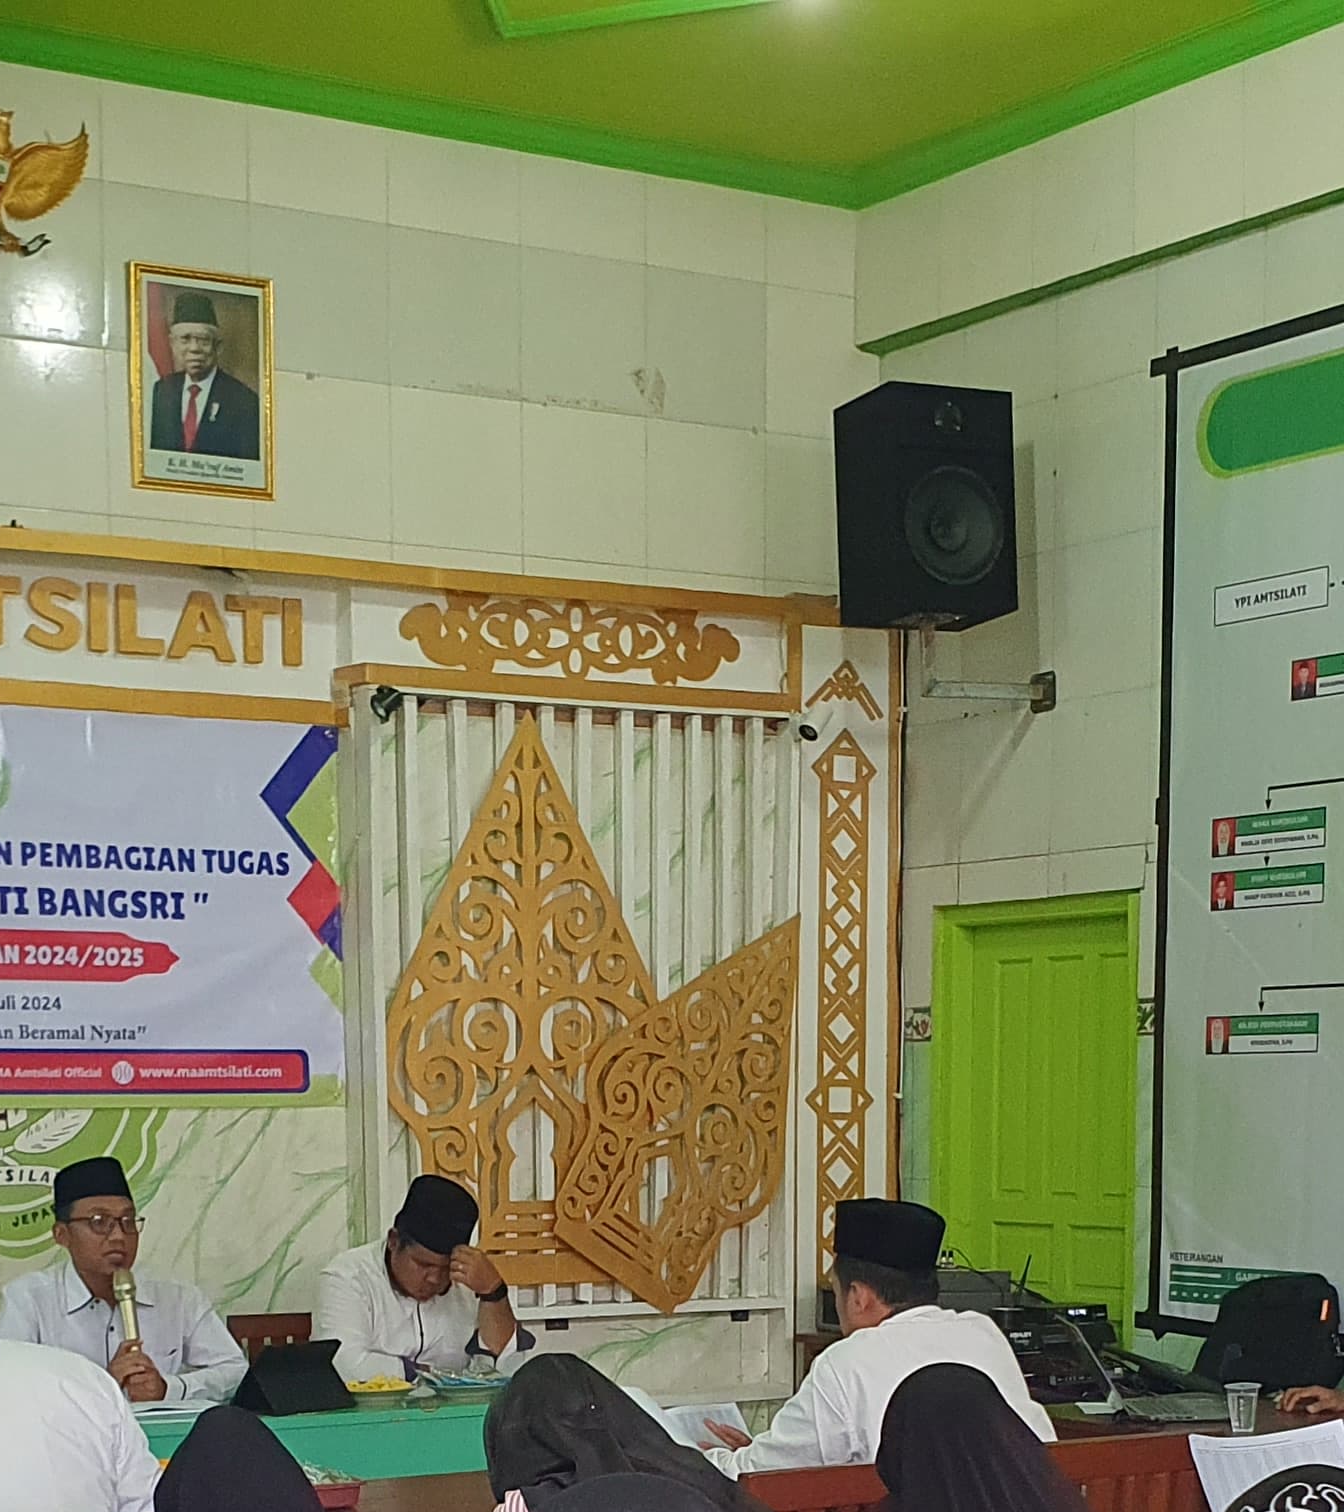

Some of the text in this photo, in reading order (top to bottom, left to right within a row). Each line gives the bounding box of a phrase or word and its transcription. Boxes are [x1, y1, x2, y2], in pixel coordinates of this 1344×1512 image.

[1235, 585, 1307, 608] YPI AMTSILATI
[20, 842, 195, 873] PEMBAGIAN
[202, 849, 290, 876] TUGAS
[38, 887, 185, 920] BANGSRI
[25, 946, 144, 968] 2024/2025
[21, 996, 61, 1011] 2024
[18, 1025, 85, 1040] Beramal
[139, 1066, 282, 1078] www.maamtsilati.com
[12, 1205, 55, 1227] JEPA
